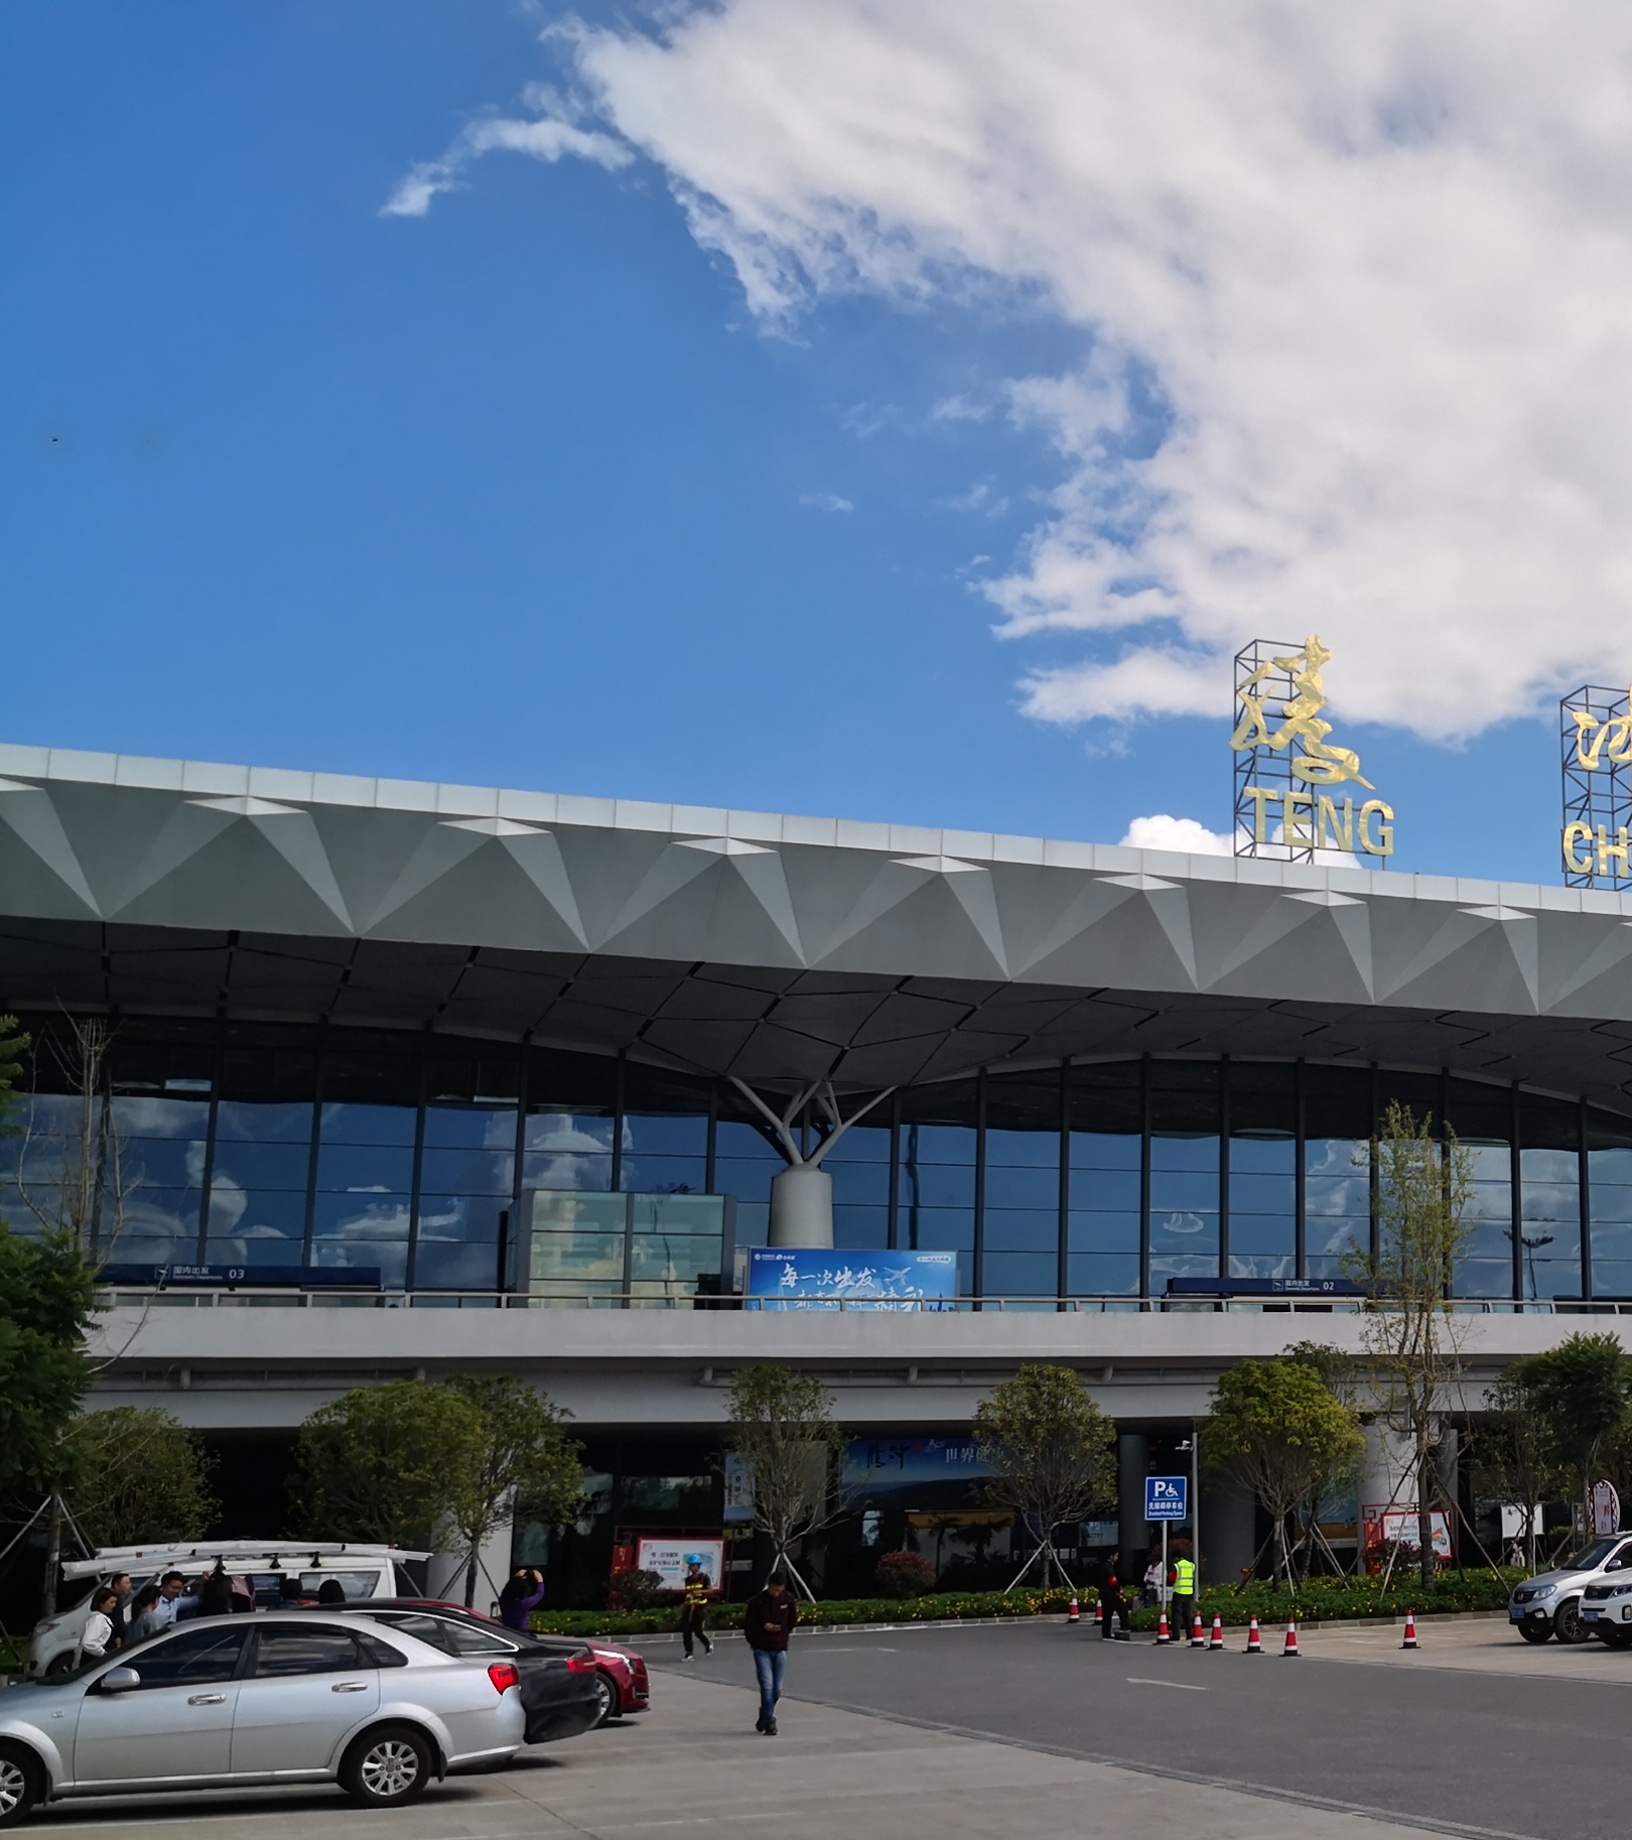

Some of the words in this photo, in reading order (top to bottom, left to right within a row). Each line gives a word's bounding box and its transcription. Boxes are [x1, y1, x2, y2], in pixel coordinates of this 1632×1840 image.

[1243, 786, 1394, 856] TENG
[173, 1266, 209, 1275] 国内出发
[229, 1269, 245, 1279] 03
[781, 1262, 877, 1289] 每一次出发
[1323, 1282, 1335, 1291] 02
[1154, 1480, 1167, 1498] P
